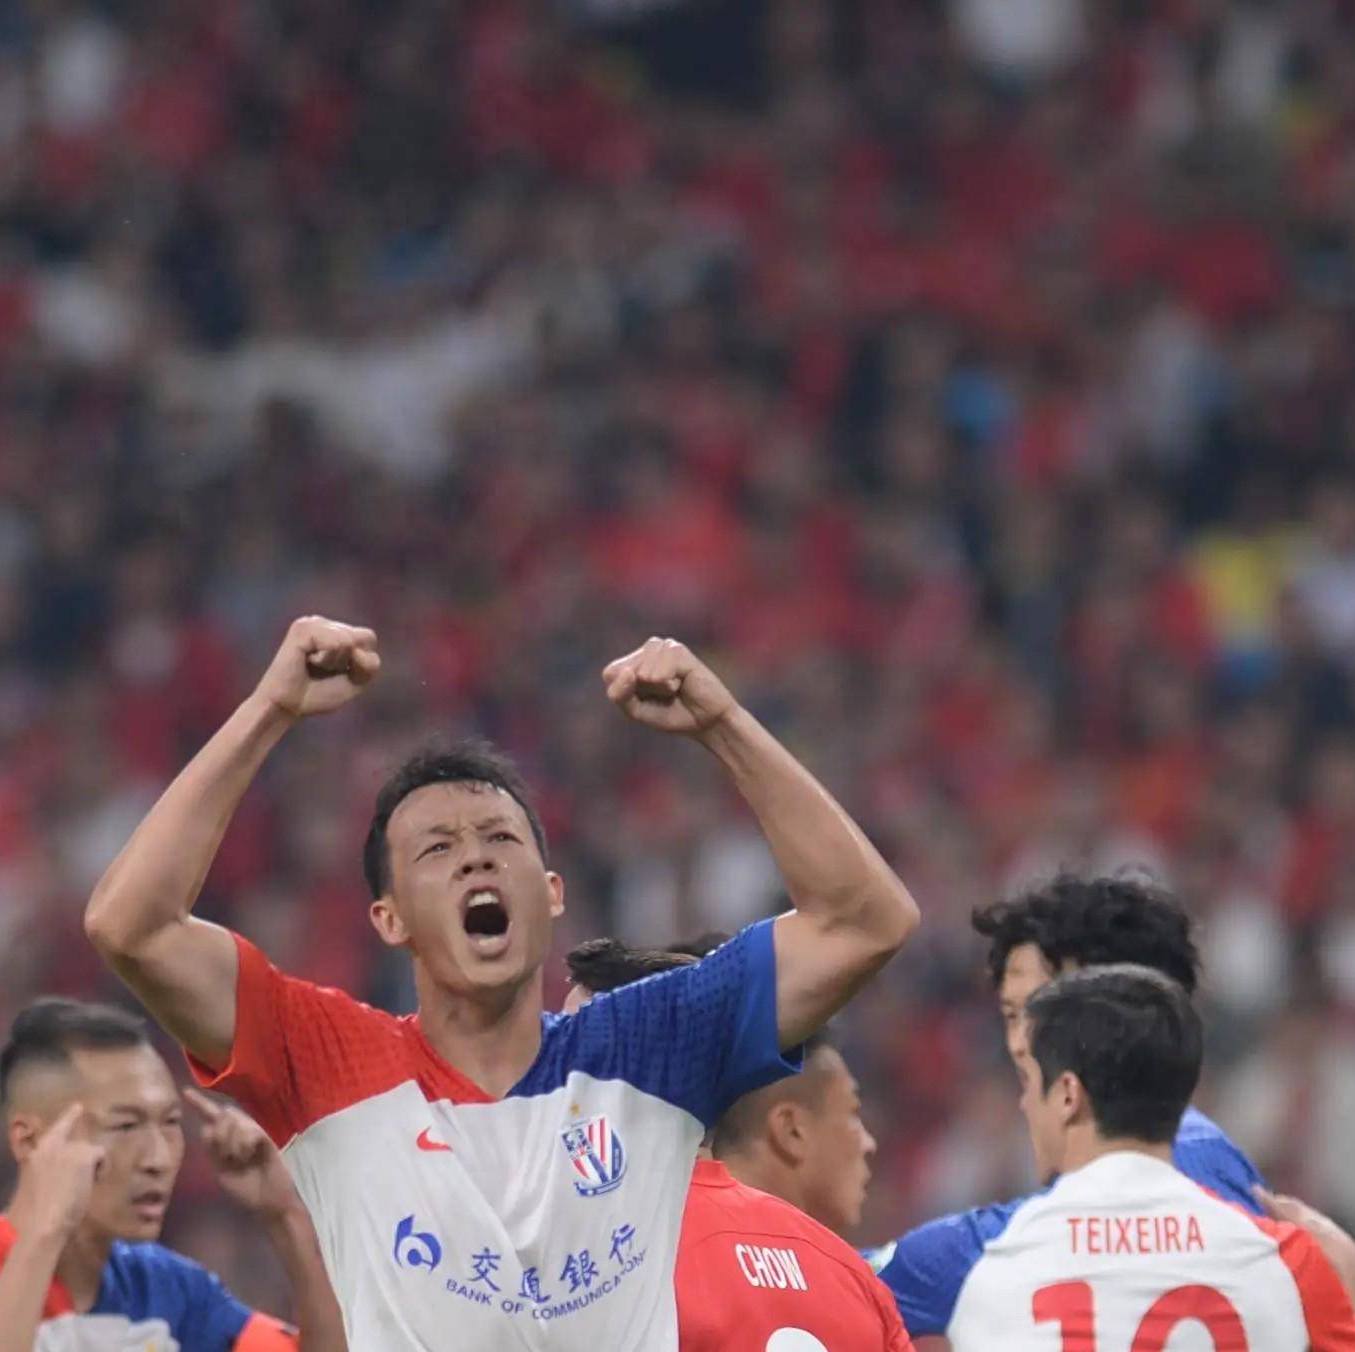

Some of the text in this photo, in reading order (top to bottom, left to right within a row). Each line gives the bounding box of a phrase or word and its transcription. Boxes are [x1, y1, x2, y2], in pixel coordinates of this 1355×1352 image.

[1067, 1216, 1205, 1254] TEIXEIRA
[446, 1246, 648, 1320] BANK OF COMMUNICAON
[734, 1243, 809, 1291] CHOW
